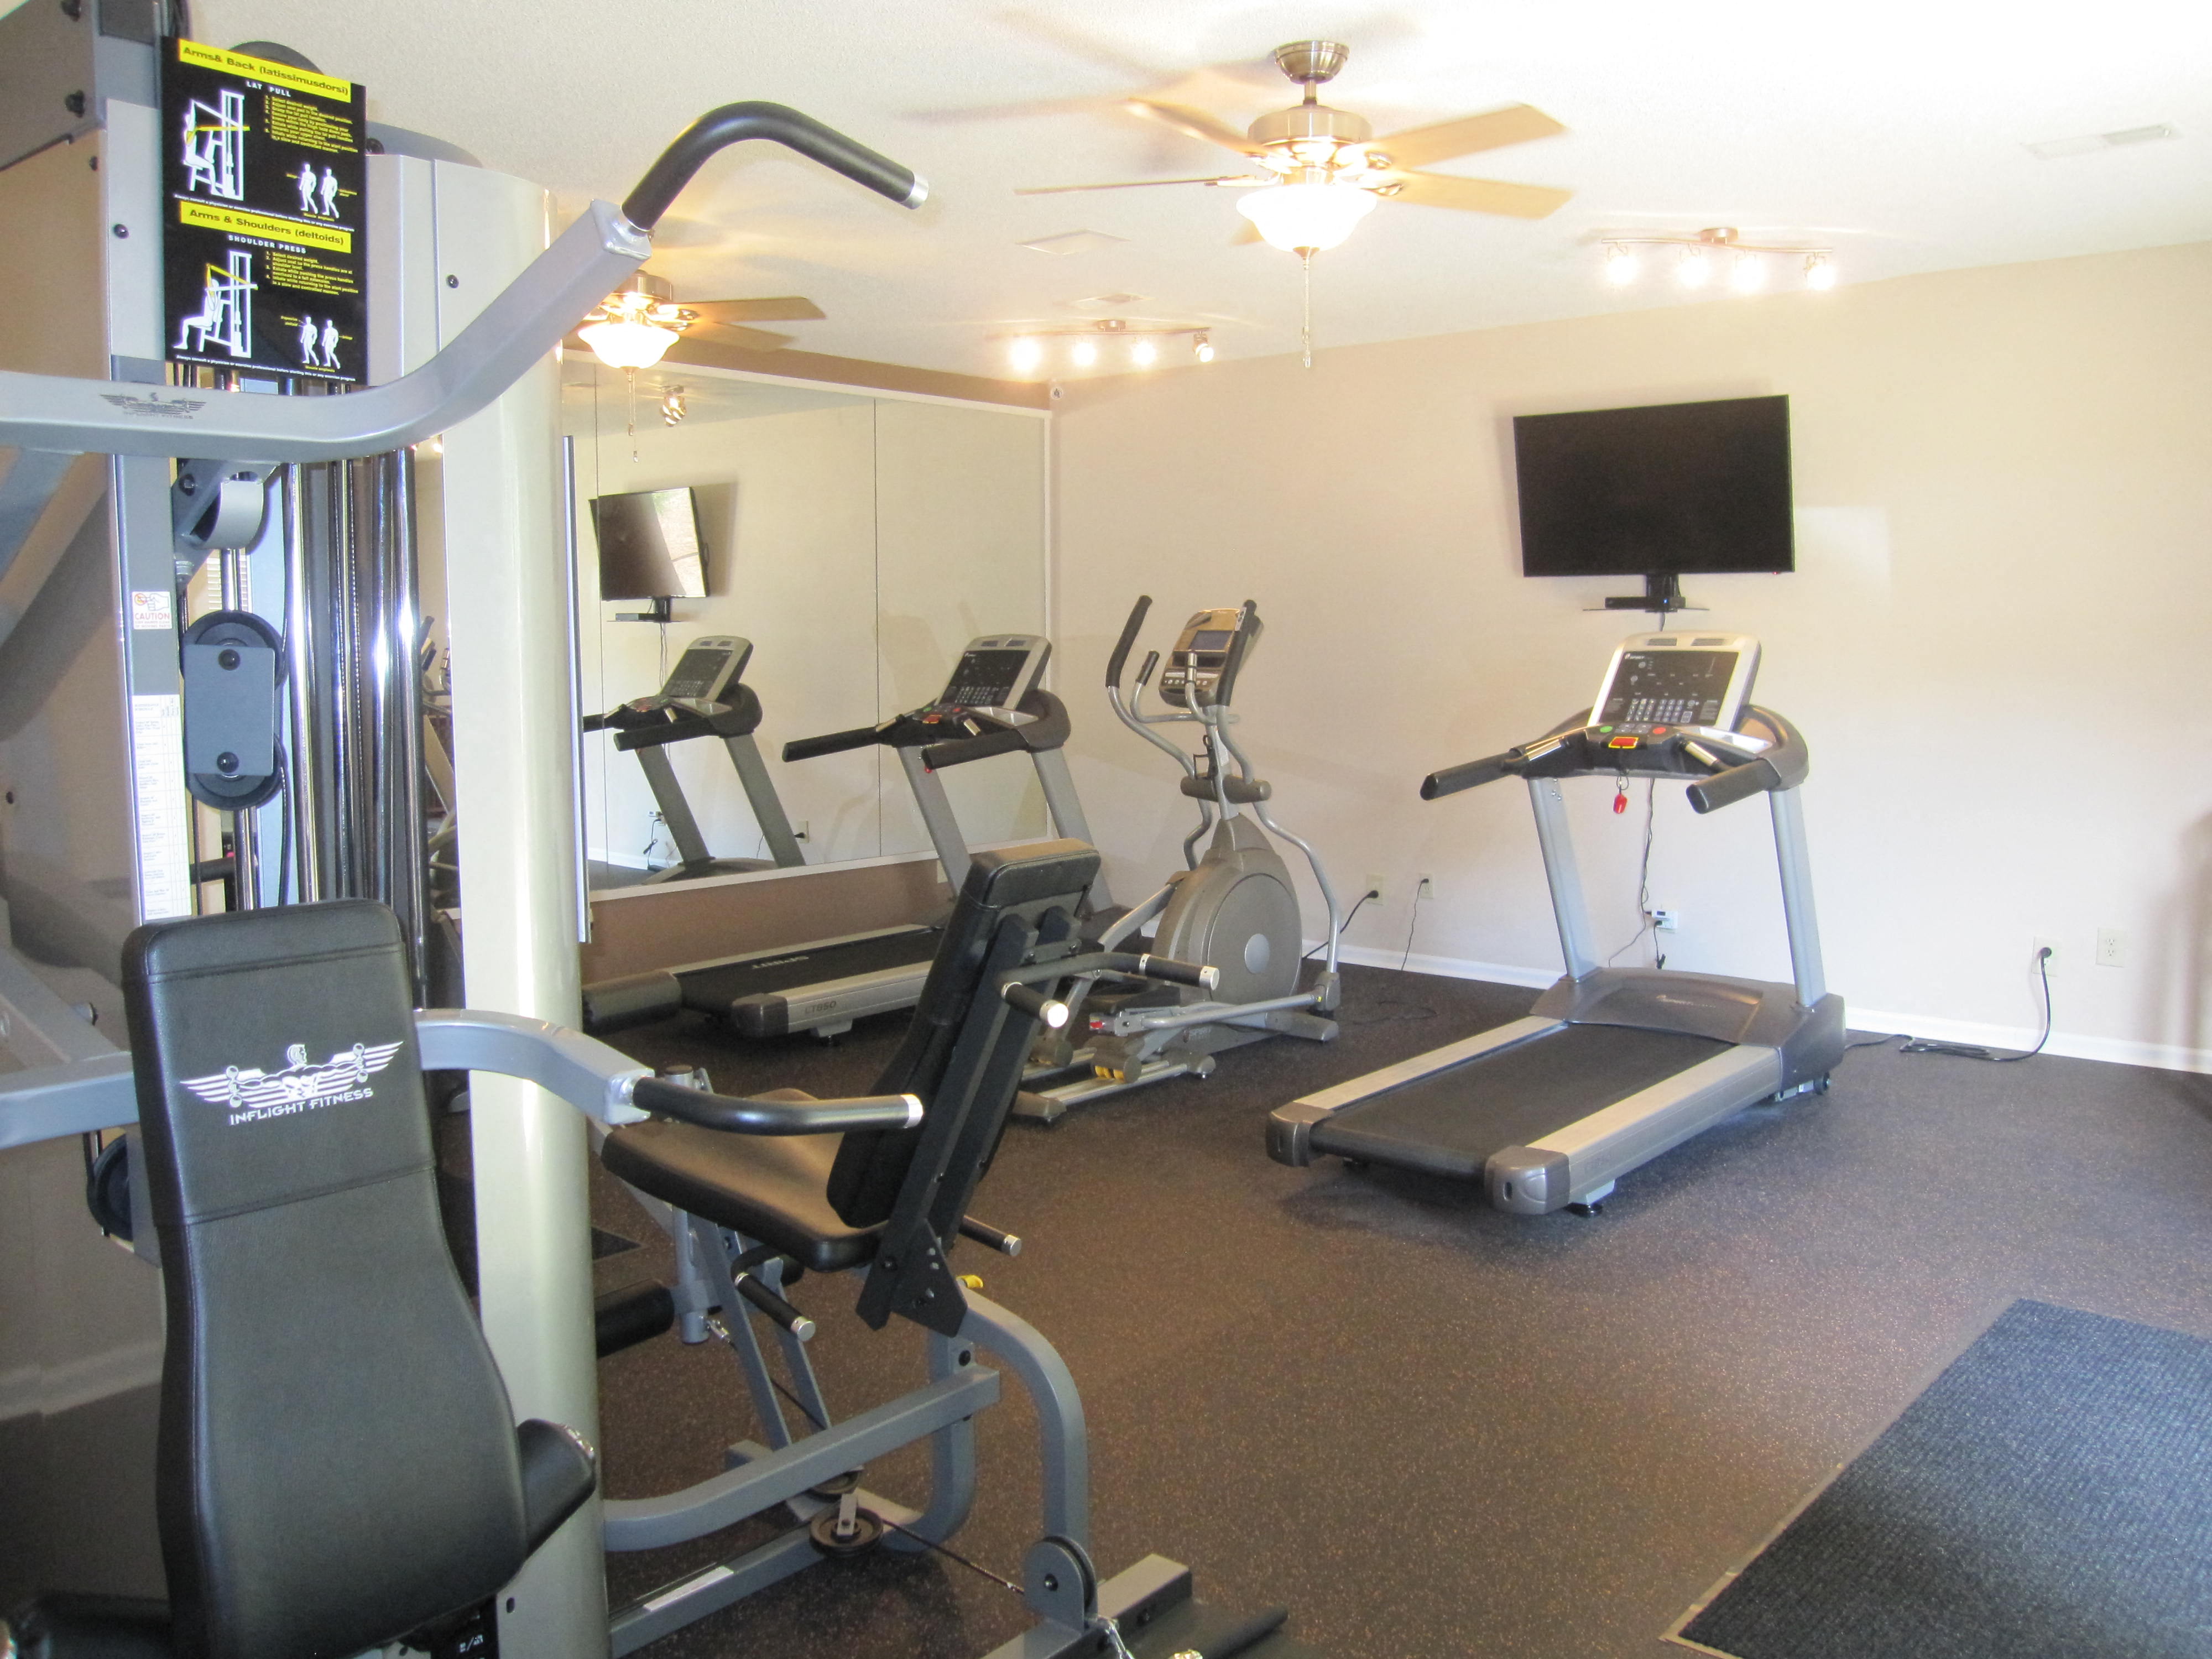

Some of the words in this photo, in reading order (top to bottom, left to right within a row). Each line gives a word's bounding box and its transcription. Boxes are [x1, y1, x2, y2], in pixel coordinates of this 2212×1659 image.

[184, 47, 223, 62] Arms&
[227, 58, 256, 71] Back
[260, 66, 348, 96] (latissimusdorsi)
[247, 81, 263, 90] LAT
[269, 86, 291, 97] PULL
[190, 210, 220, 221] Arms
[236, 218, 291, 234] Shoulders
[295, 229, 343, 245] (deltoids)
[228, 235, 275, 248] SHOULDER
[279, 244, 306, 254] PRESS
[805, 1000, 836, 1014] LT850
[228, 1102, 306, 1126] INFLIGHT
[309, 1088, 373, 1109] FITNESS
